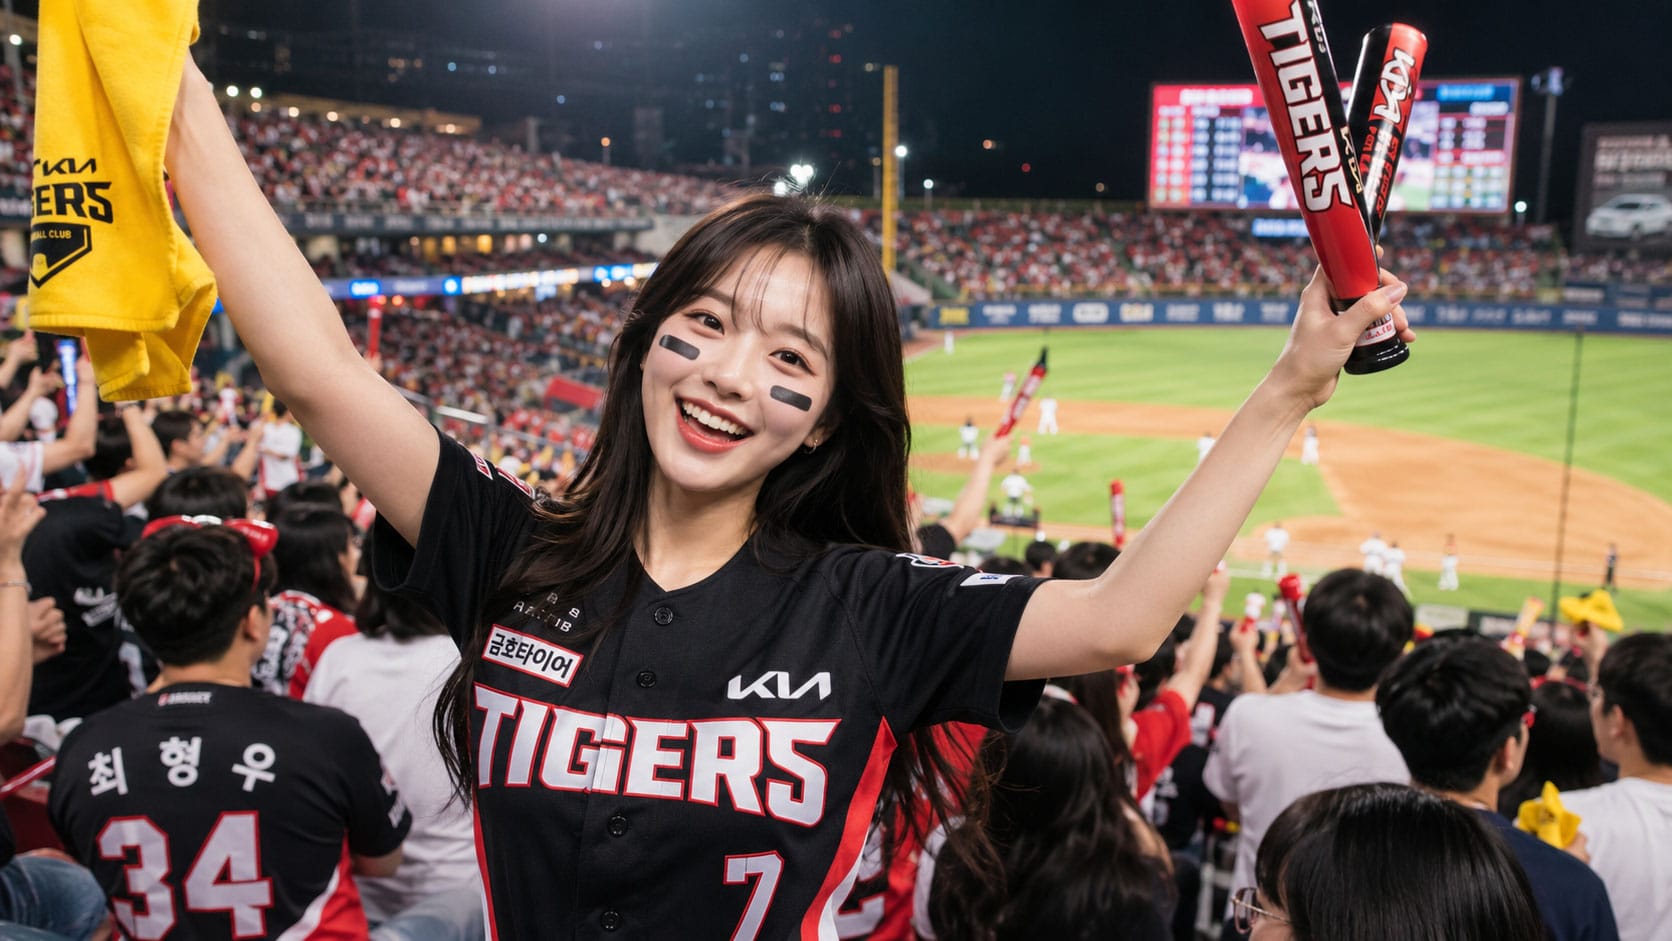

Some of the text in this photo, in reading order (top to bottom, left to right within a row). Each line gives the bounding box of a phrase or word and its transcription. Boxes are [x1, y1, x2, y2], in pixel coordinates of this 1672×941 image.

[1257, 0, 1353, 213] TIGERS
[32, 181, 114, 224] ERS
[48, 229, 72, 239] CLUB
[488, 633, 574, 678] 금호타이어
[473, 681, 842, 828] TIGERS
[95, 810, 274, 941] 34
[723, 850, 785, 941] 7
